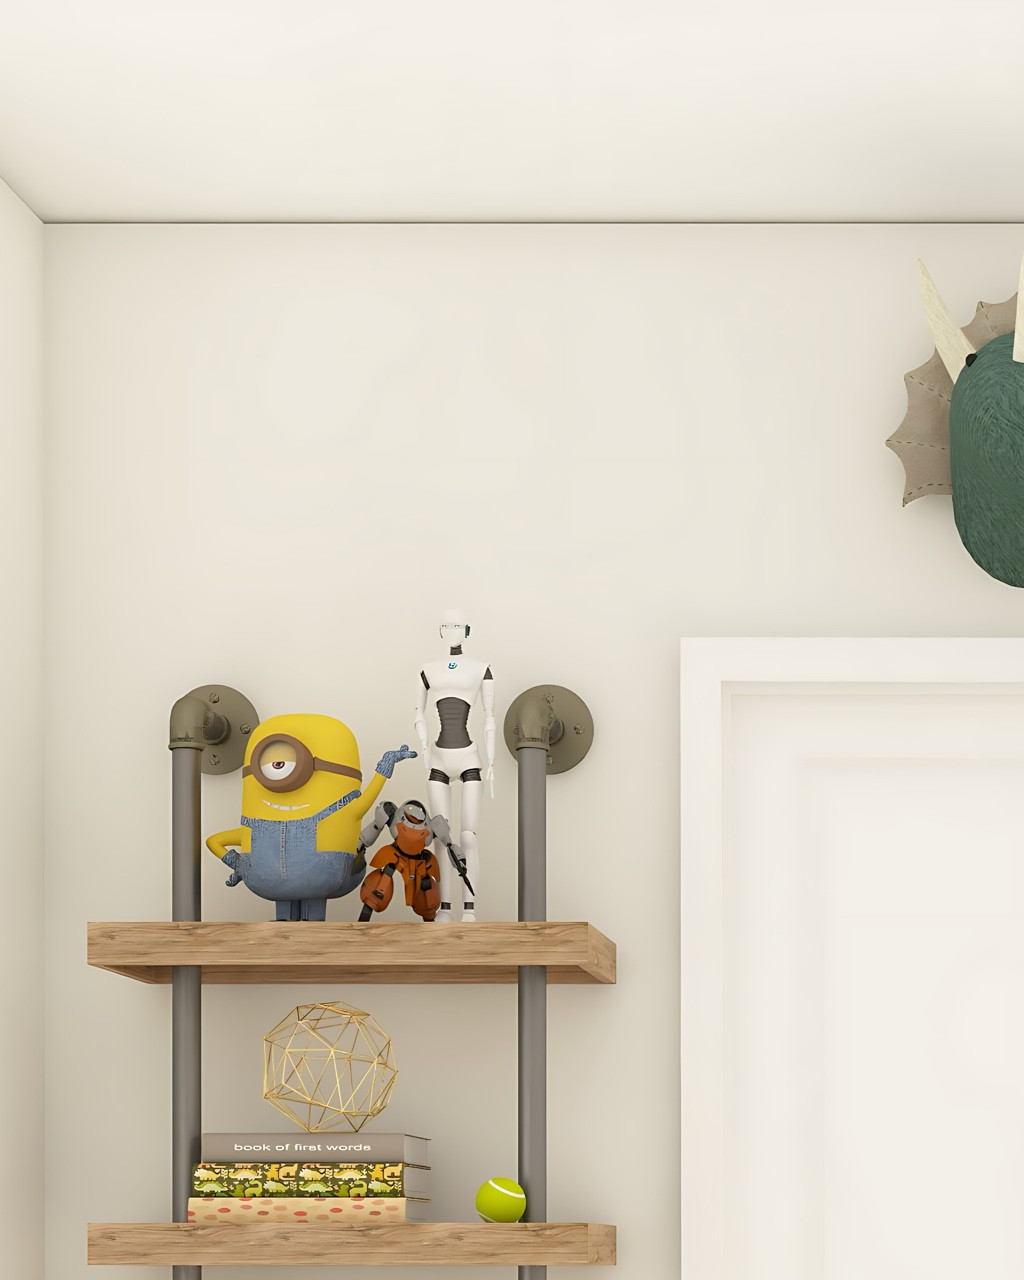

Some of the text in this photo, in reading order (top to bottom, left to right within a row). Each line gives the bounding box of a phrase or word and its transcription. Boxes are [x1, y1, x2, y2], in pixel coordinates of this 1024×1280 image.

[234, 1143, 372, 1151] book of first words
